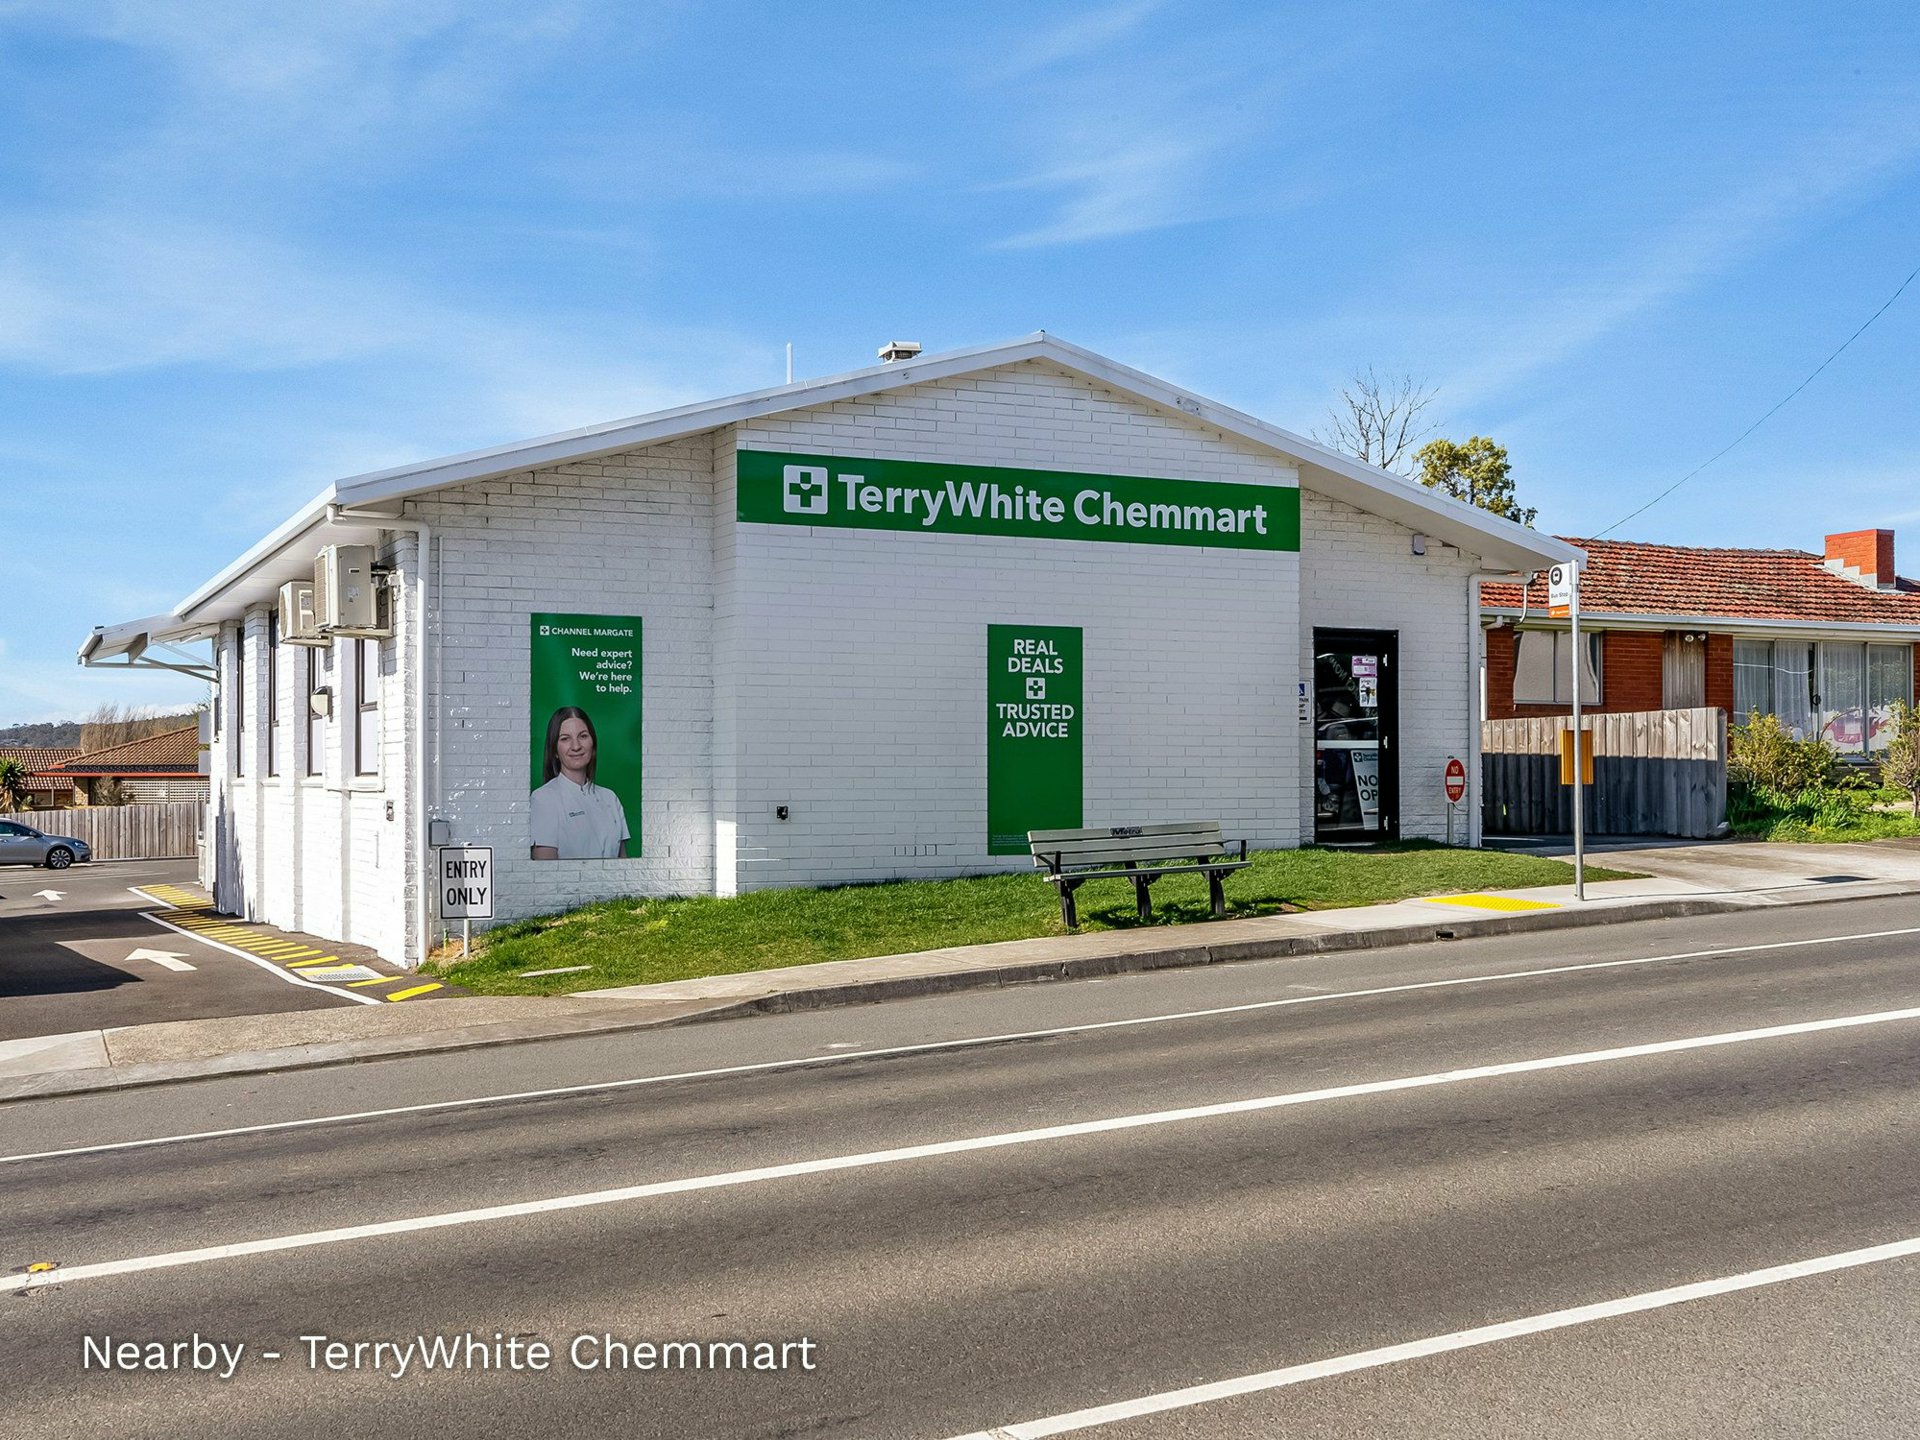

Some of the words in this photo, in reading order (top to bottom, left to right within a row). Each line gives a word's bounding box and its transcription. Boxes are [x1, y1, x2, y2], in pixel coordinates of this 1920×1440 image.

[837, 474, 1066, 526] TerryWhite
[1073, 489, 1268, 536] Chemmart
[551, 627, 592, 636] CHANNEL
[593, 628, 634, 637] MARGATE
[571, 647, 598, 657] Need
[600, 649, 633, 659] expert
[1013, 639, 1058, 655] REAL
[596, 660, 633, 670] advice?
[1007, 657, 1064, 674] DEALS
[579, 671, 609, 681] We're
[610, 671, 633, 681] here
[595, 684, 607, 692] to
[608, 683, 632, 695] help.
[996, 703, 1075, 720] TRUSTED
[1002, 721, 1069, 738] ADVICE
[1450, 765, 1459, 775] NO
[1448, 786, 1462, 794] ENTRY
[446, 860, 487, 879] ENTRY
[446, 887, 488, 906] ONLY
